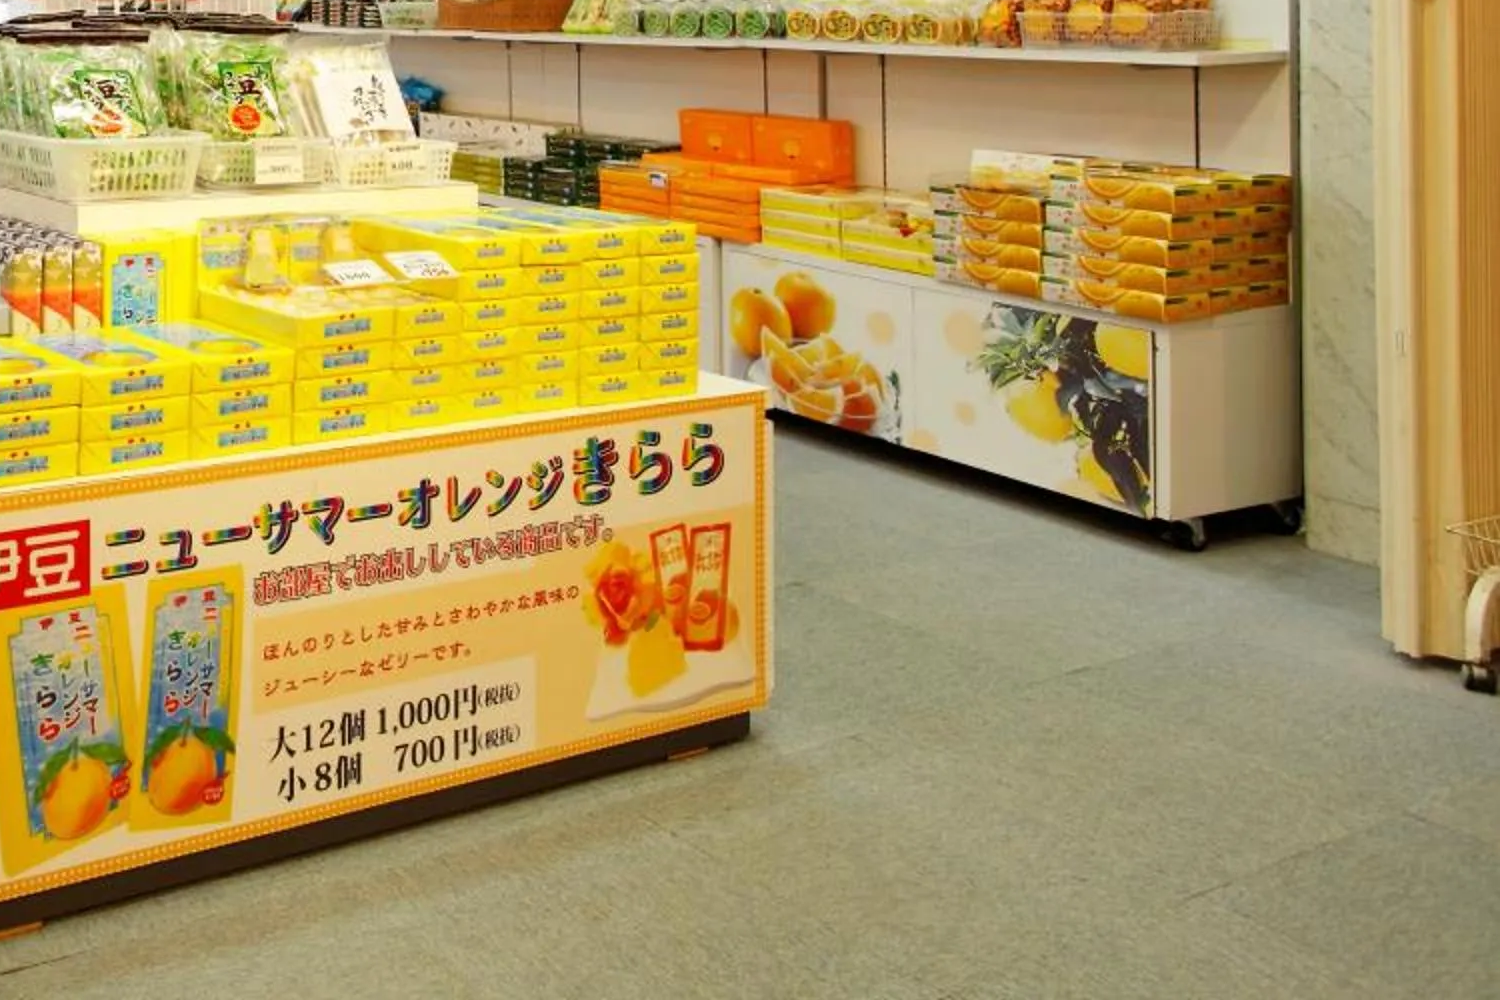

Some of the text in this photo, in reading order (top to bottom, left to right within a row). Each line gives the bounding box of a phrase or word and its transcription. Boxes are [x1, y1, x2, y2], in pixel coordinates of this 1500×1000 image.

[101, 423, 725, 580] ニューサマーオレンジきらら
[253, 514, 613, 606] お部屋でお出ししている商品です。
[262, 584, 580, 662] ほんのりとした甘みとさわやかな風味の
[30, 652, 62, 742] きらら
[163, 629, 188, 714] きらら
[264, 641, 472, 697] ジューシーなゼリーです。
[269, 708, 367, 764] 大12個
[277, 751, 363, 802] 小8個
